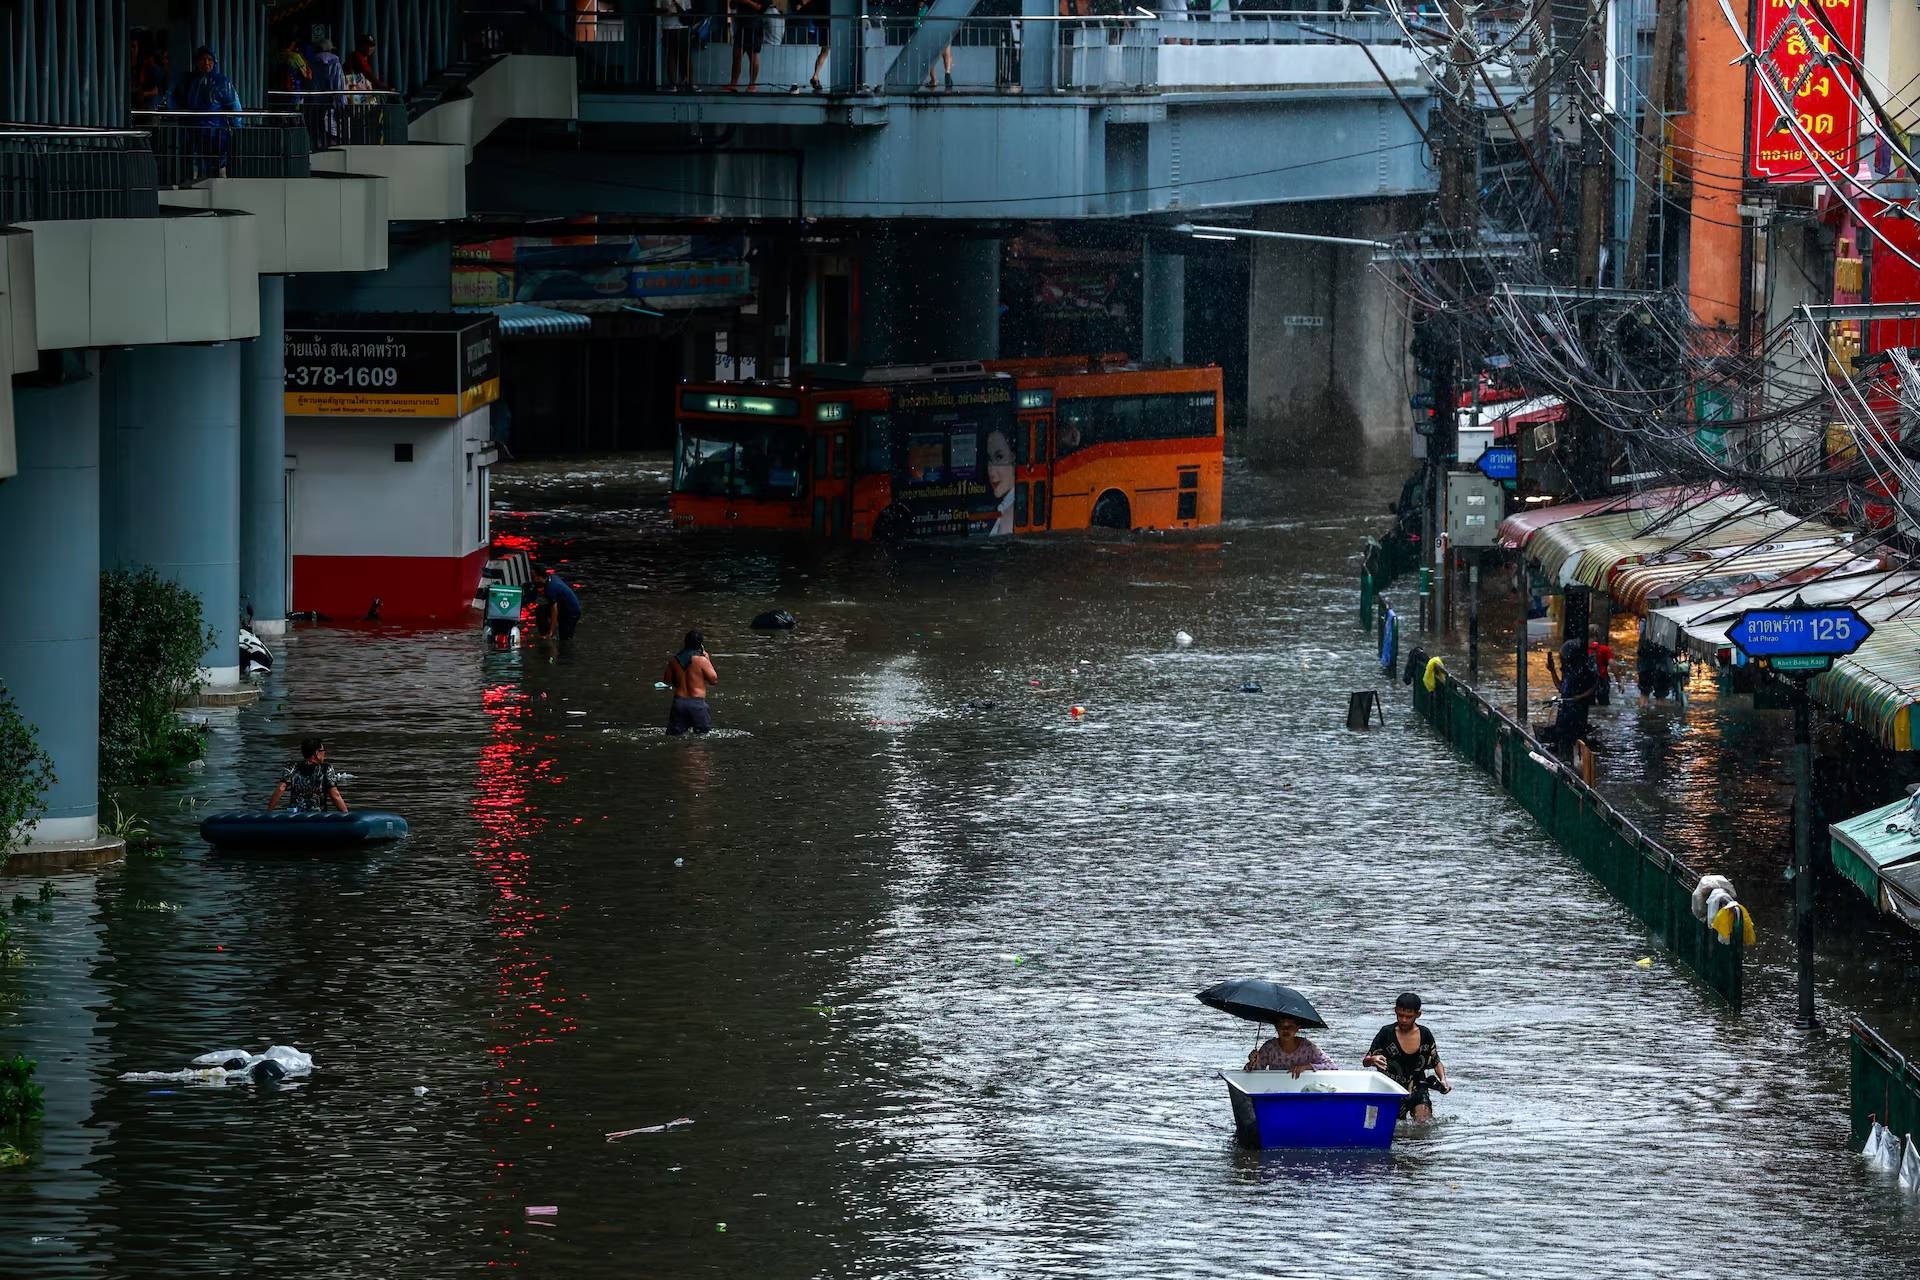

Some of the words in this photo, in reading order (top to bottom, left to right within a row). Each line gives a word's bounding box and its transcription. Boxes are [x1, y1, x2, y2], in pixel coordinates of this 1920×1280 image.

[717, 399, 737, 410] 145
[1748, 615, 1804, 633] ลาดพร้าว
[1810, 617, 1851, 641] 125
